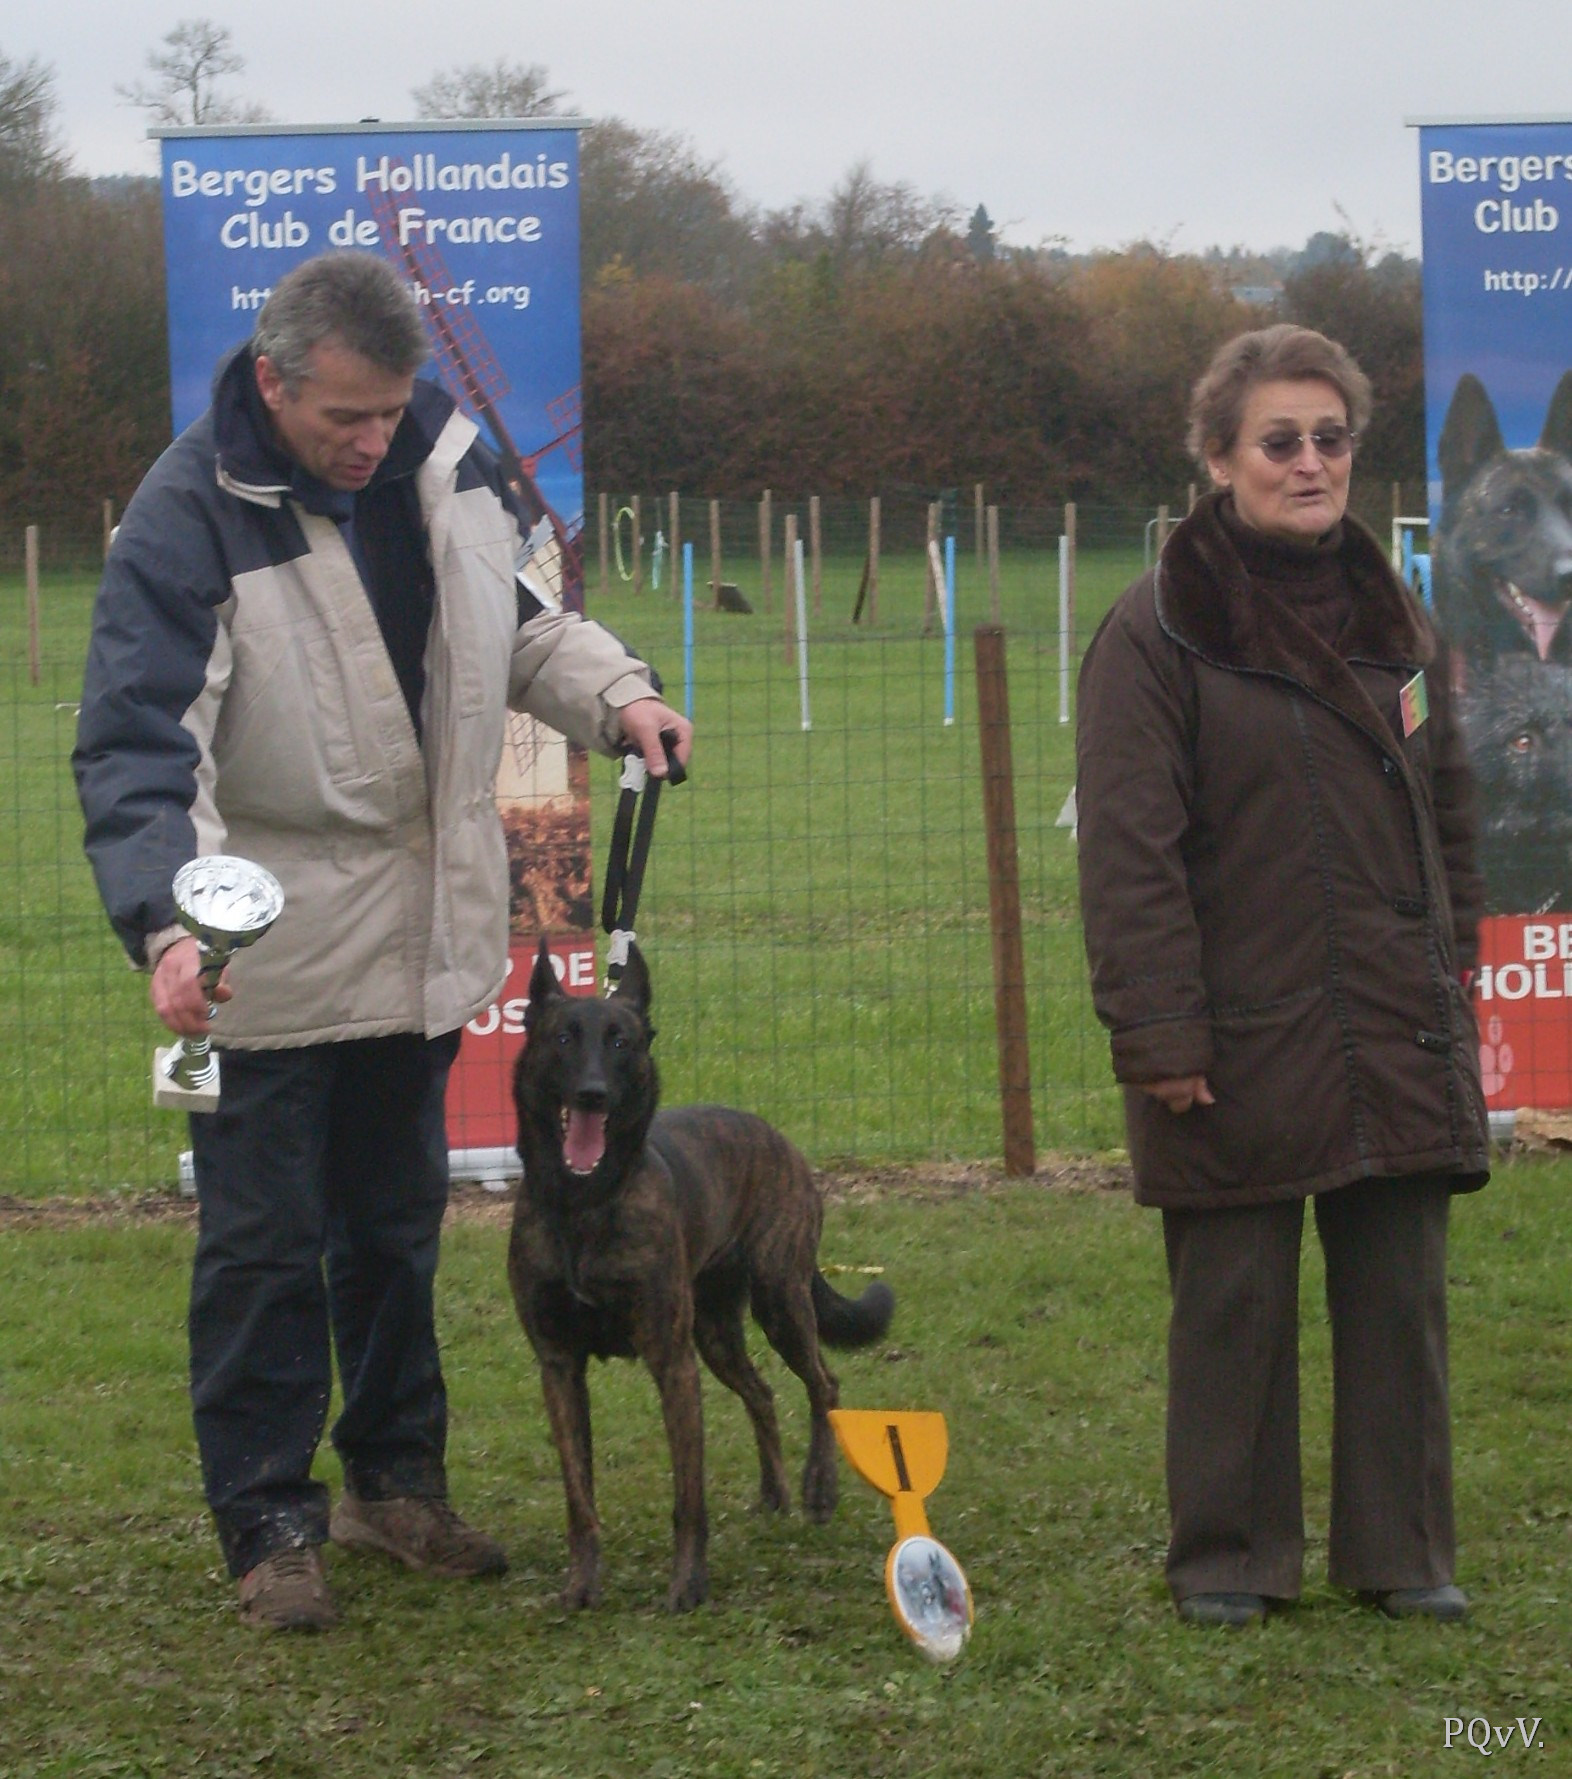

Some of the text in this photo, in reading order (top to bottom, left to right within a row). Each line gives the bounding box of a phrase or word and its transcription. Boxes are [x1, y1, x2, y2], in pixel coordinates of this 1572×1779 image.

[171, 152, 570, 208] Bergers Hollandais
[220, 207, 542, 250] Club de France
[1474, 198, 1560, 234] Club
[884, 1424, 914, 1492] 1
